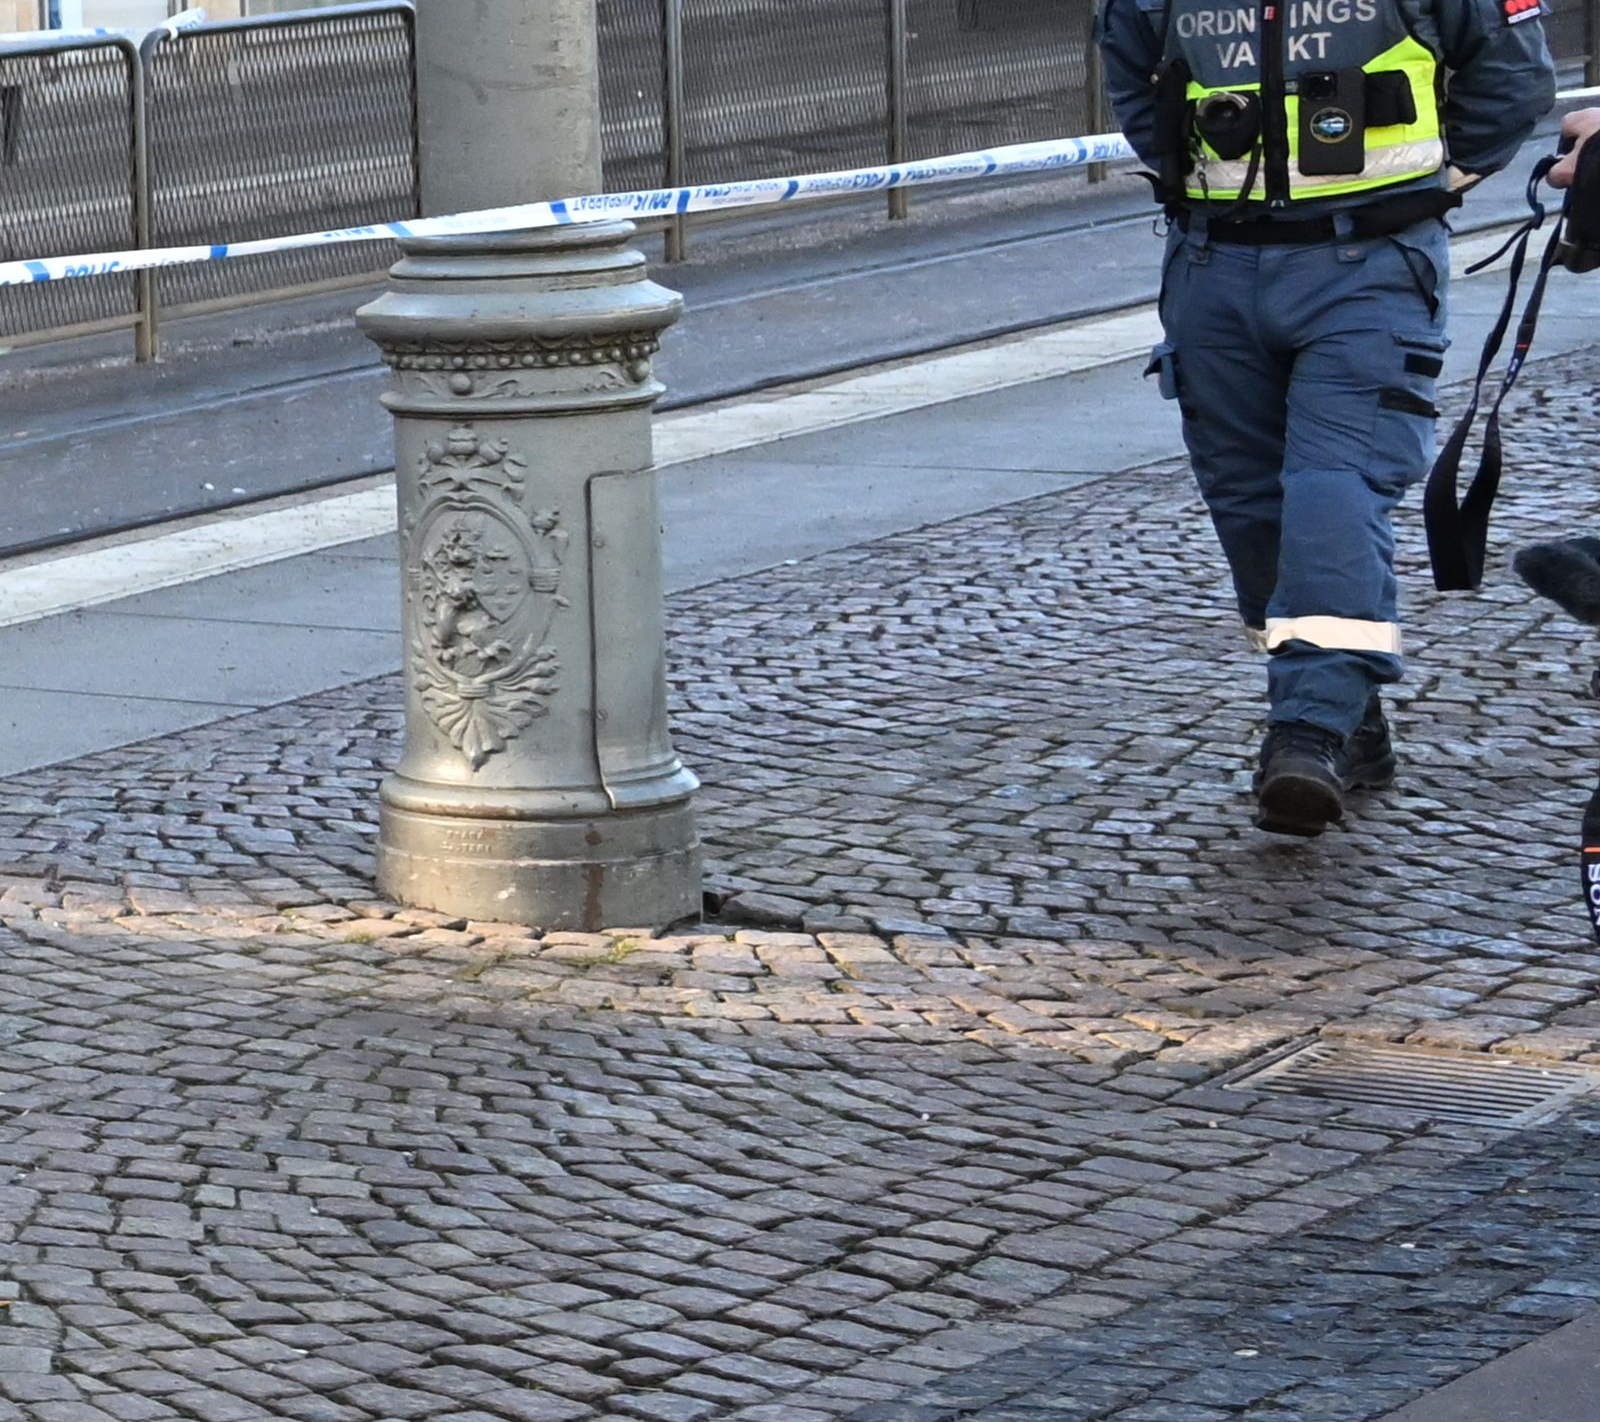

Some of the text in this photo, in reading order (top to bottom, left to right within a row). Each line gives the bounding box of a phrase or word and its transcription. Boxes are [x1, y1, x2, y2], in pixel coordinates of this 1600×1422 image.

[1176, 7, 1256, 38] ORDN
[1216, 32, 1332, 68] VA KT
